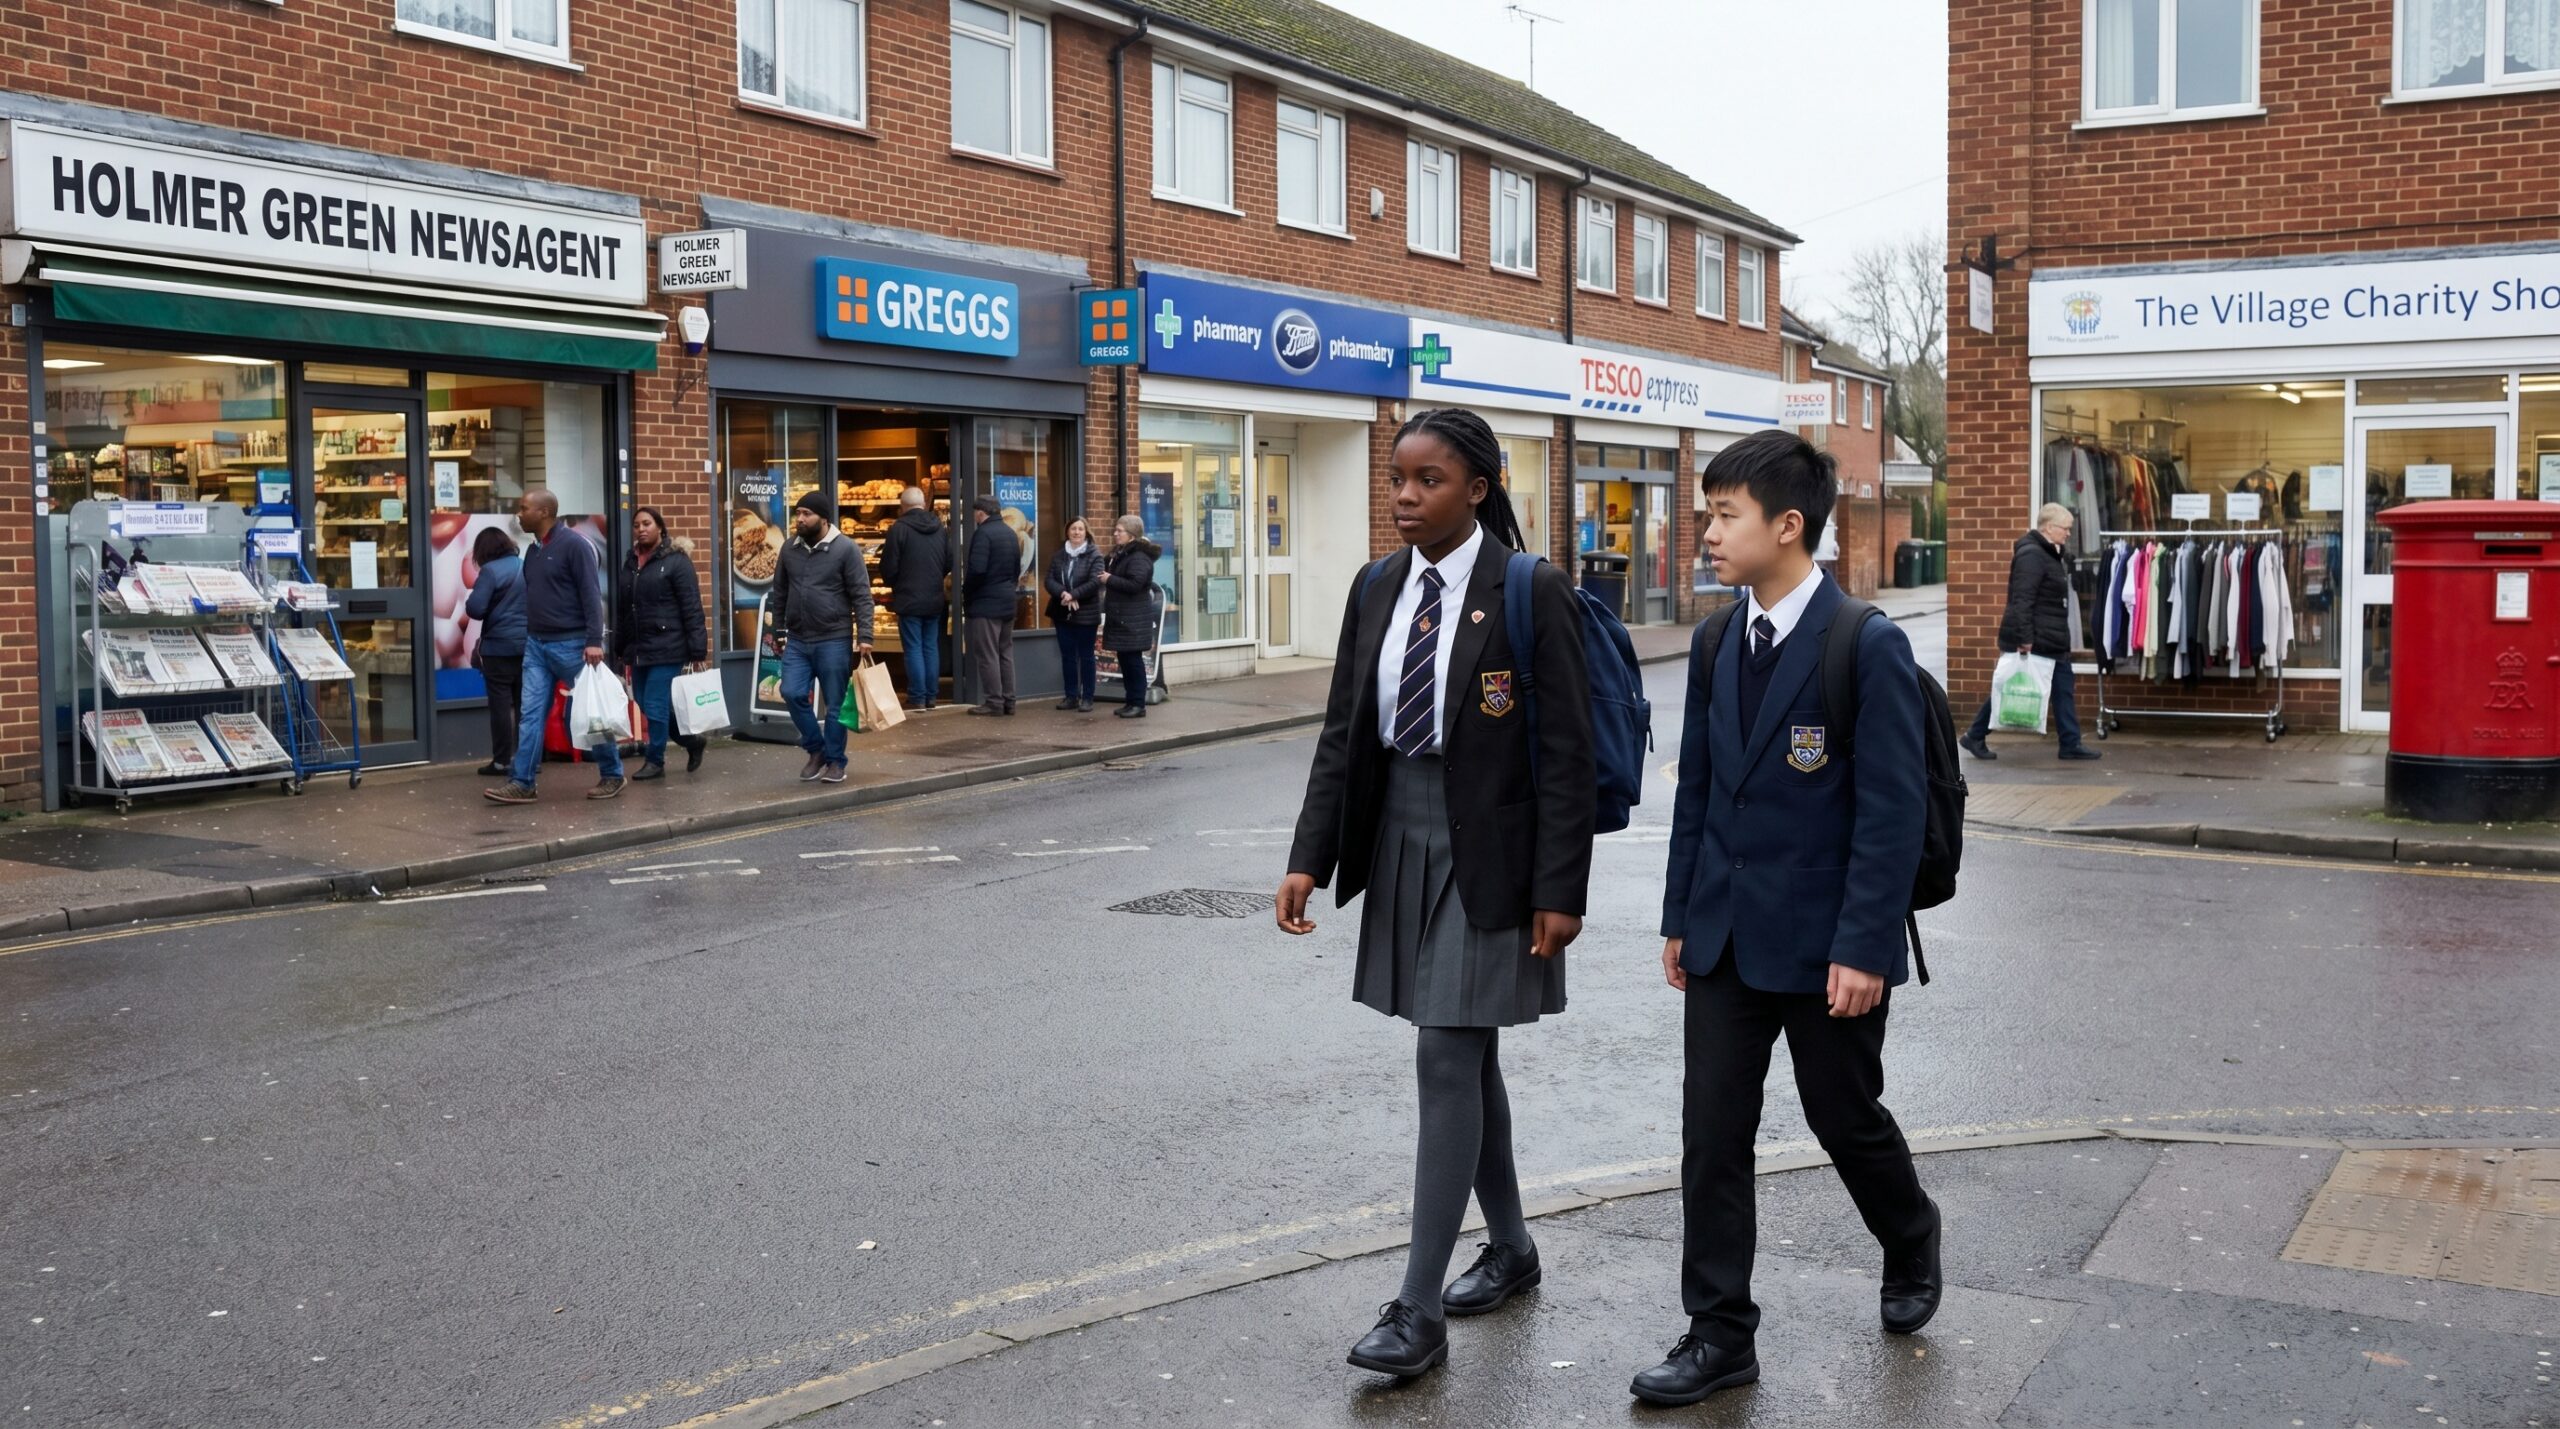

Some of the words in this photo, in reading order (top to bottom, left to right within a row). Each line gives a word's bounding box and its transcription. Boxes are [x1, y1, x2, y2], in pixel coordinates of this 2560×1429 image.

[53, 156, 248, 236] HOLMER
[262, 188, 396, 254] GREEN
[411, 210, 621, 281] NEWSAGENT
[674, 238, 720, 252] HOLMER
[679, 254, 717, 269] GREEN
[663, 270, 732, 287] NEWSAGENT
[877, 280, 1010, 341] GREGGS
[2135, 295, 2198, 328] The
[2211, 290, 2330, 329] Village
[2343, 284, 2479, 322] Charity
[2491, 278, 2560, 312] Sho
[1089, 346, 1129, 357] GREGGS
[1581, 359, 1643, 398] TESCO
[1646, 377, 1700, 412] express
[1785, 394, 1825, 403] TESCO
